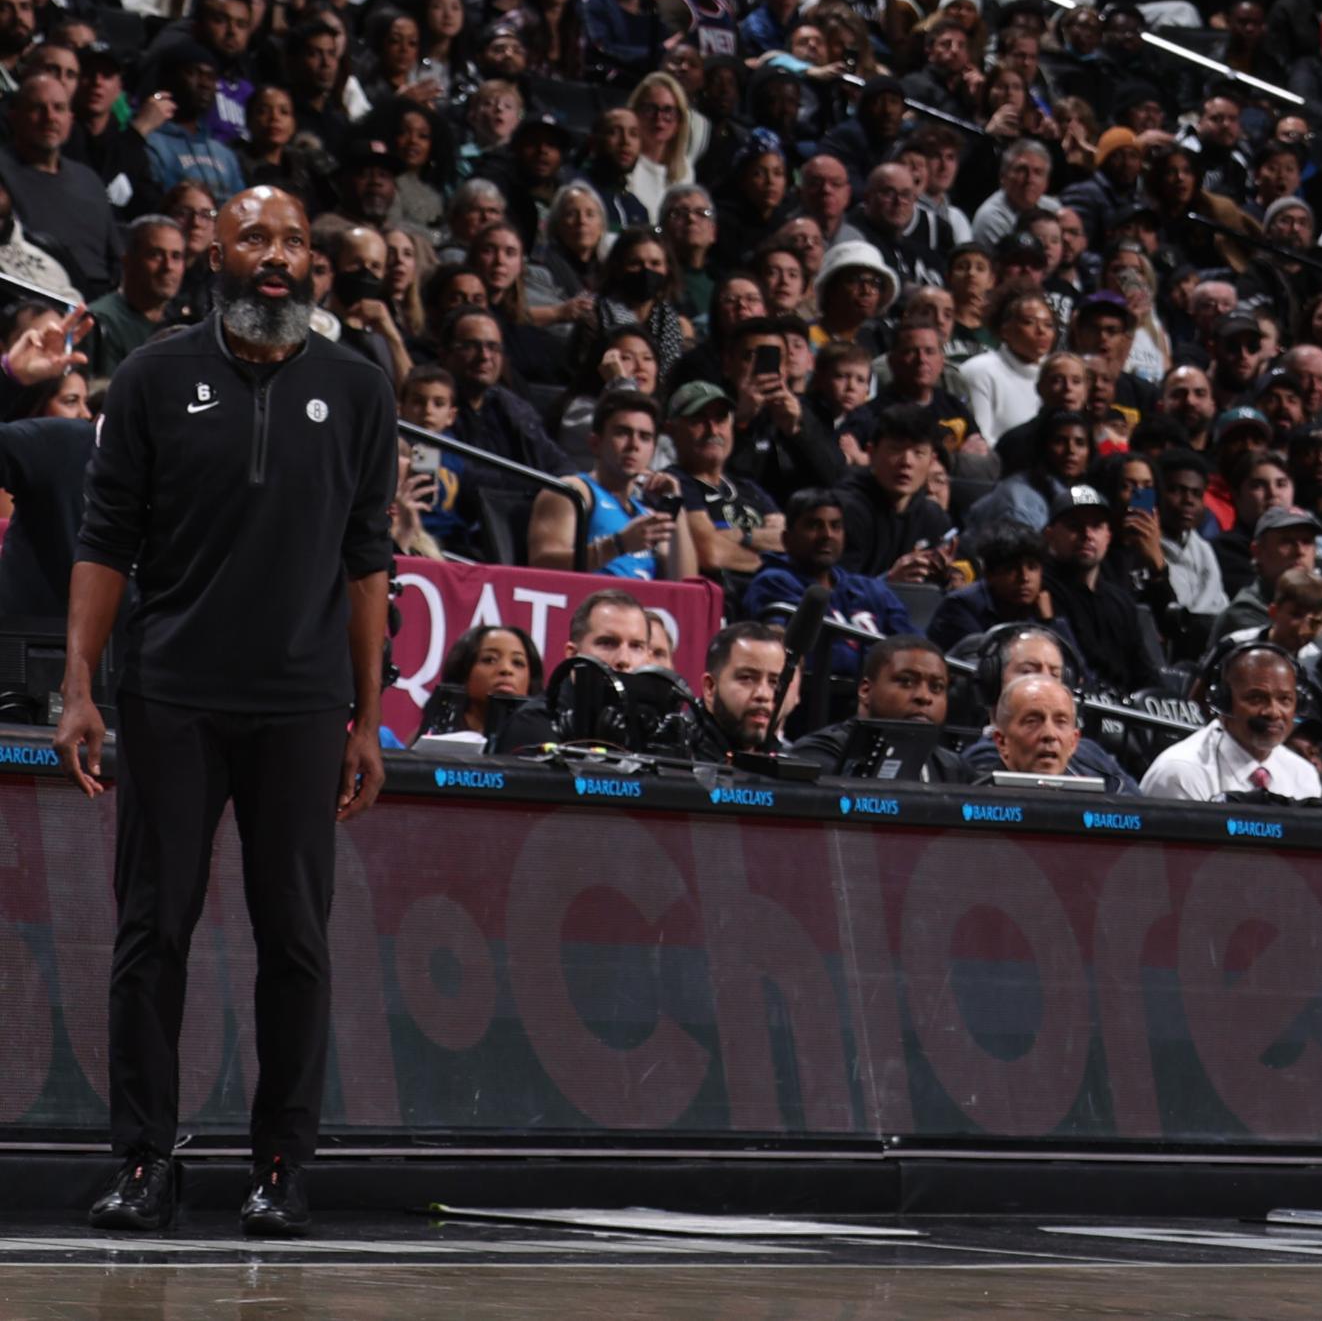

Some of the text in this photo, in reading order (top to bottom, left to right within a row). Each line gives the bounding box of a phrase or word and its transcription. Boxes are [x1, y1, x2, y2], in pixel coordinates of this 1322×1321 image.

[447, 769, 505, 789] BARCLAYS
[587, 778, 641, 797] BARCLAYS
[720, 788, 774, 806] BARCLAYS
[973, 803, 1024, 822] BARCLAYS
[1094, 813, 1142, 830] BARCLAYS
[1234, 821, 1283, 838] BARCLAYS
